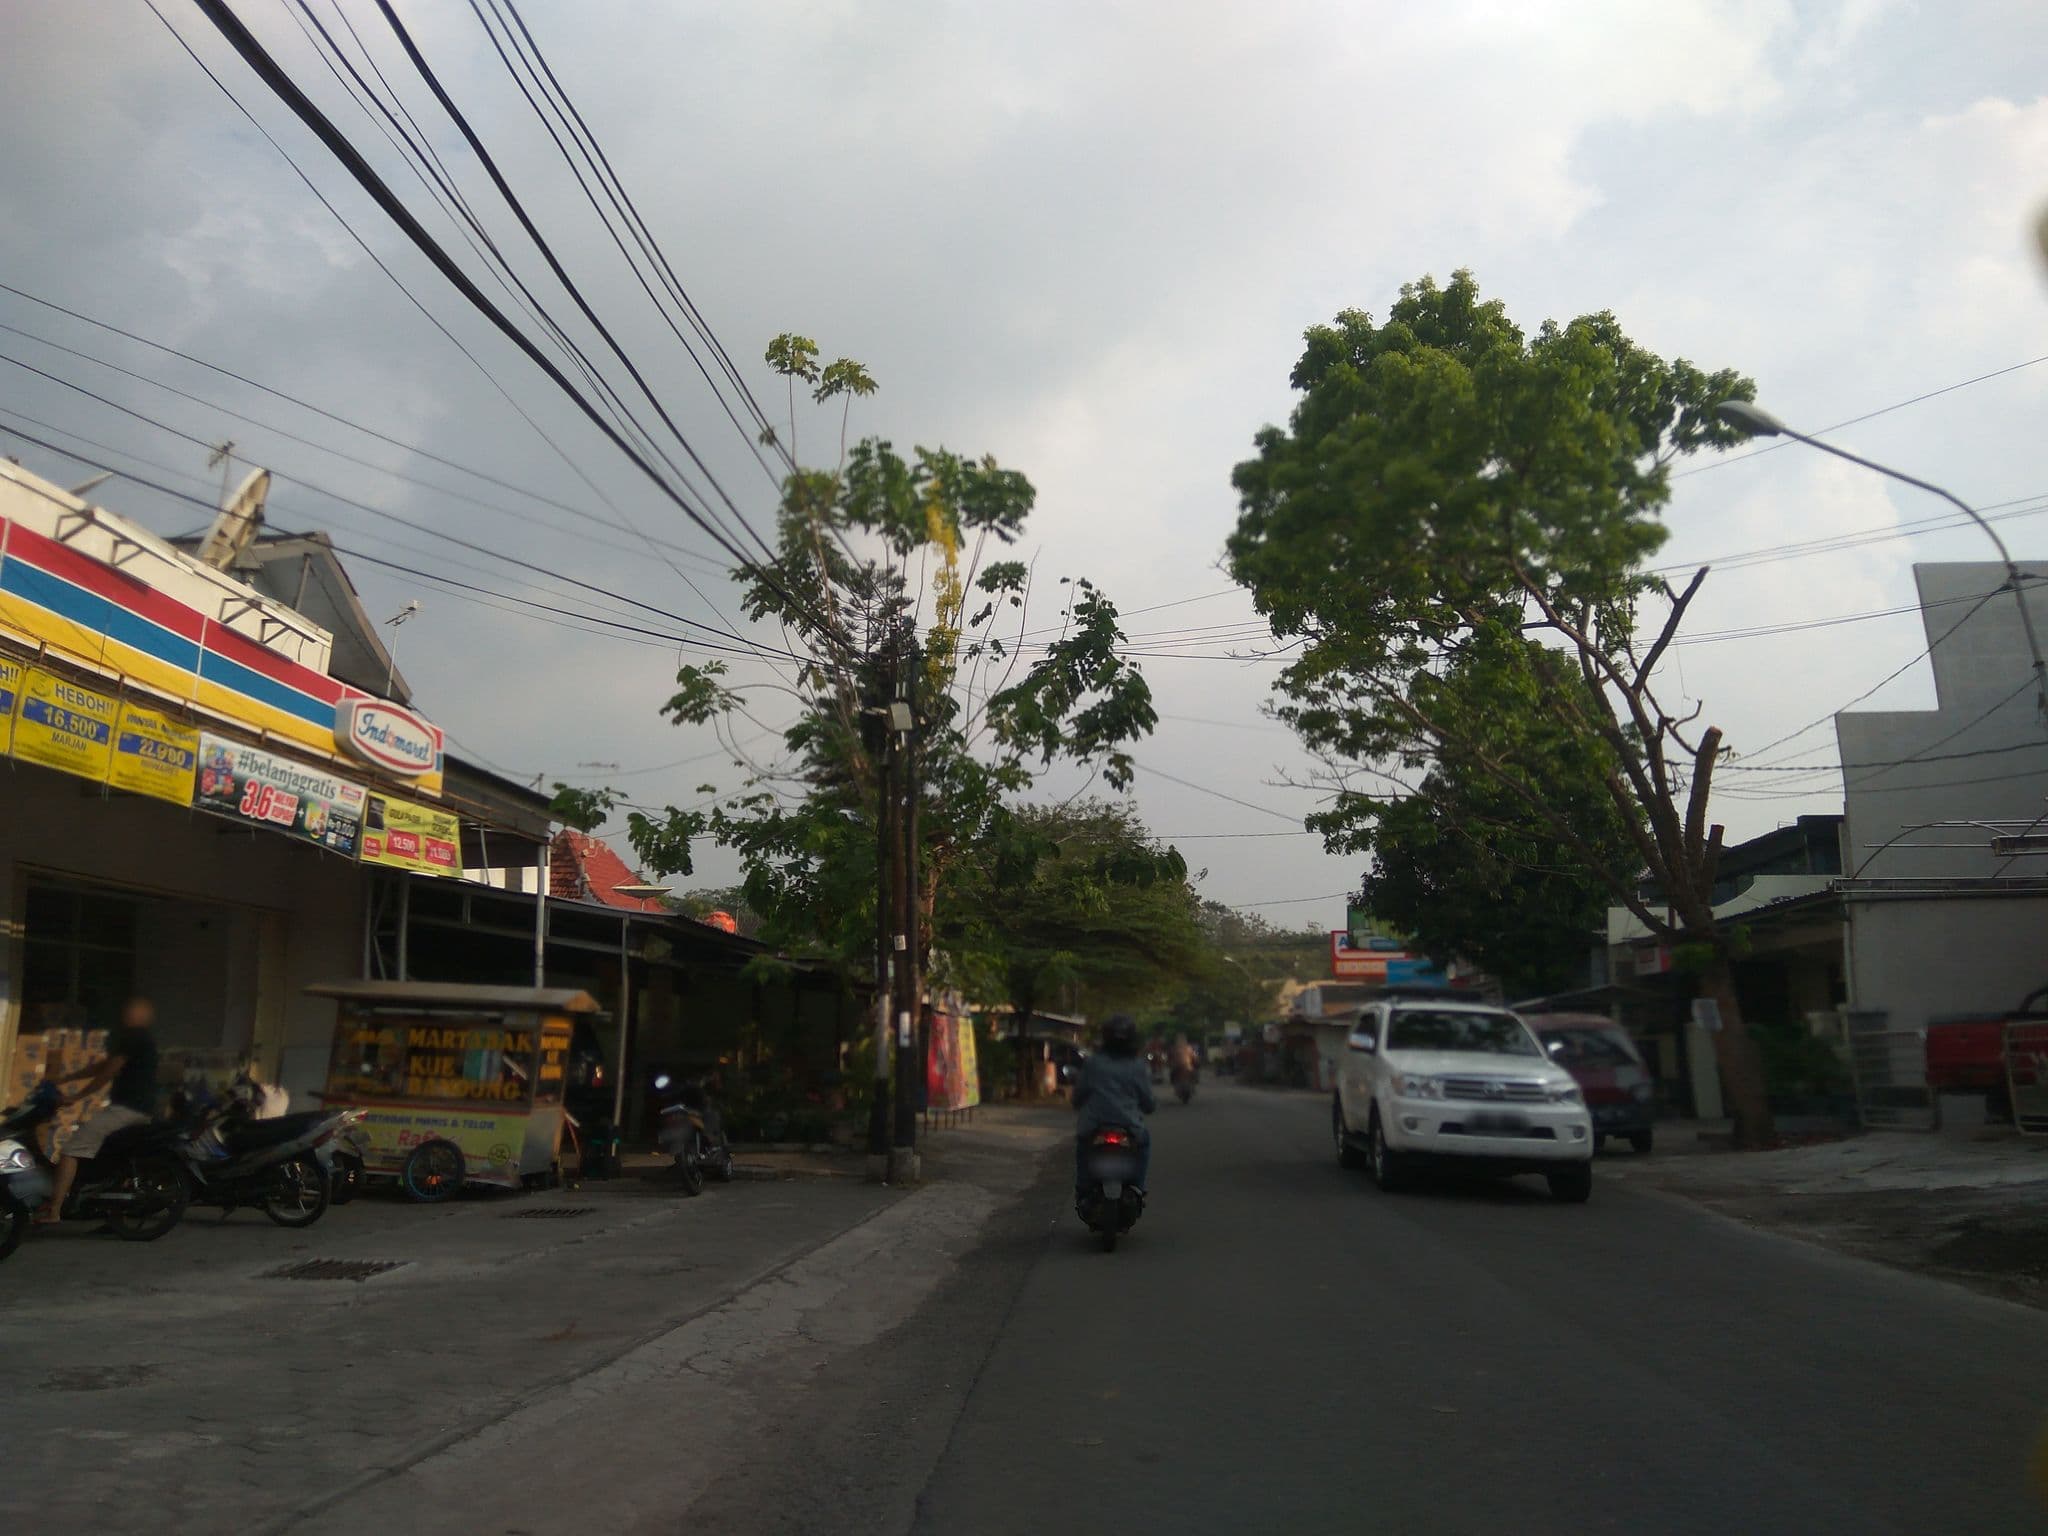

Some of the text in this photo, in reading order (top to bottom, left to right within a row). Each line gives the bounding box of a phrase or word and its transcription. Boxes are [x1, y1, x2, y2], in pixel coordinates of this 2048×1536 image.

[54, 682, 114, 716] HEBOH!!
[44, 706, 97, 739] 16.500
[358, 713, 430, 761] Indomaret
[237, 749, 338, 801] #belanjagratis
[408, 1026, 533, 1052] MARTABAK
